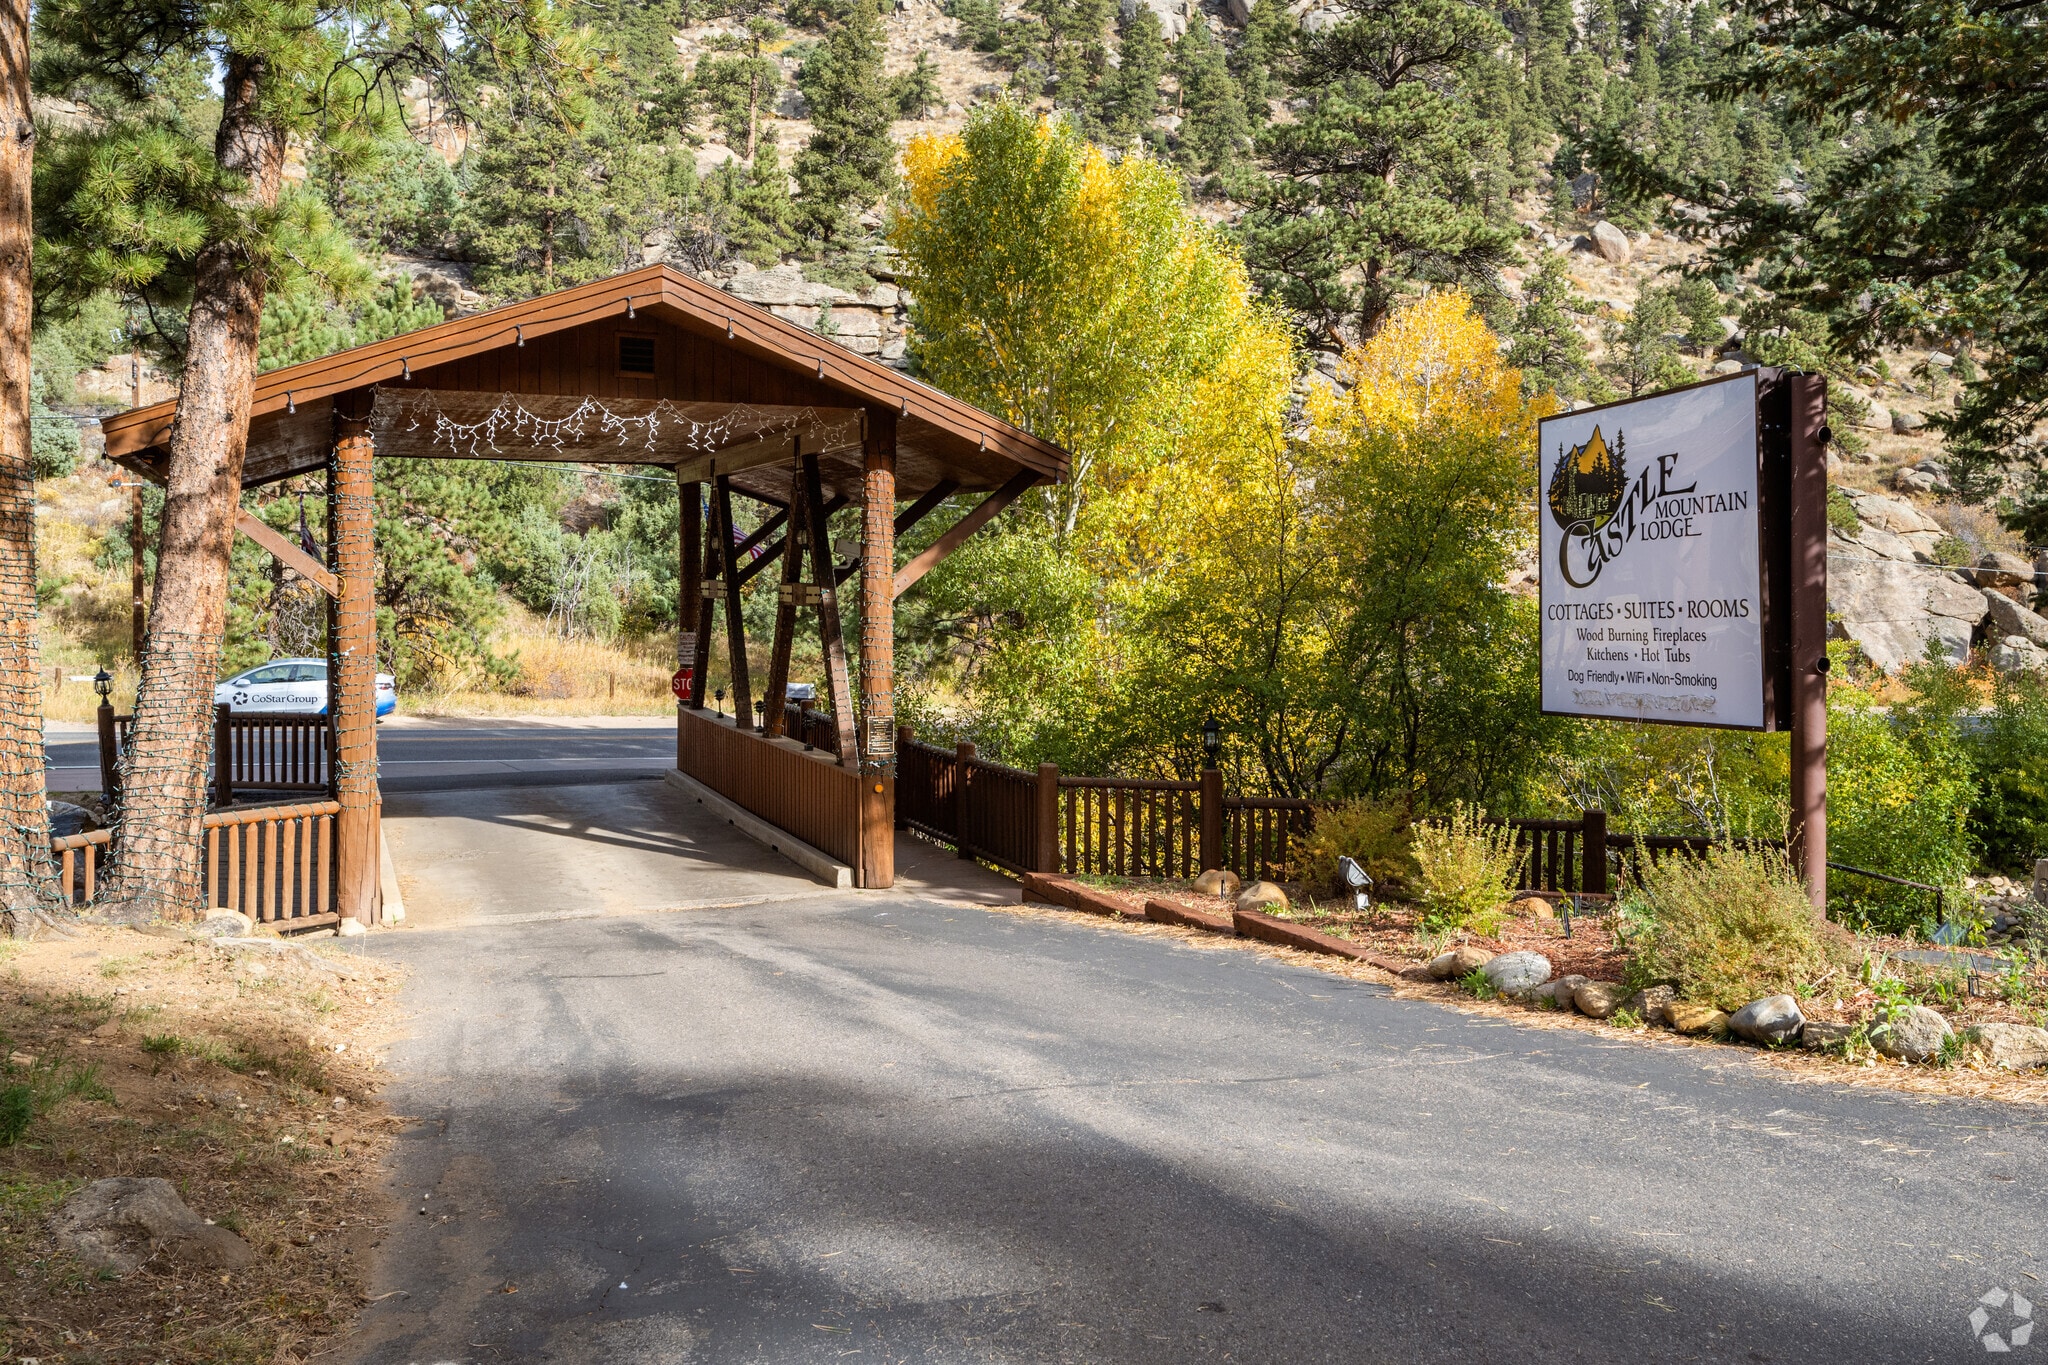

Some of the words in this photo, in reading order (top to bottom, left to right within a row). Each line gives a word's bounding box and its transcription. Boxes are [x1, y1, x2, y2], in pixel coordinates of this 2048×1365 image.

[1655, 491, 1748, 519] MOUNTAIN
[1641, 517, 1702, 541] LODGE
[1548, 602, 1614, 621] COTTAGES
[1624, 601, 1675, 619] SUITES
[1687, 599, 1749, 618] ROOMS
[1576, 627, 1603, 642] Wood
[1608, 628, 1648, 645] Burning
[1653, 627, 1707, 645] Fireplaces
[1587, 647, 1629, 661] Kitchens
[1641, 648, 1660, 662] Hot
[1664, 648, 1691, 663] Tubs
[673, 678, 692, 690] STO
[1567, 669, 1584, 684] Dog
[1587, 670, 1619, 685] Friendly
[1626, 671, 1645, 684] WiFi
[1652, 672, 1717, 690] Non-Smoking
[252, 694, 286, 703] CoStar
[286, 694, 318, 704] Group
